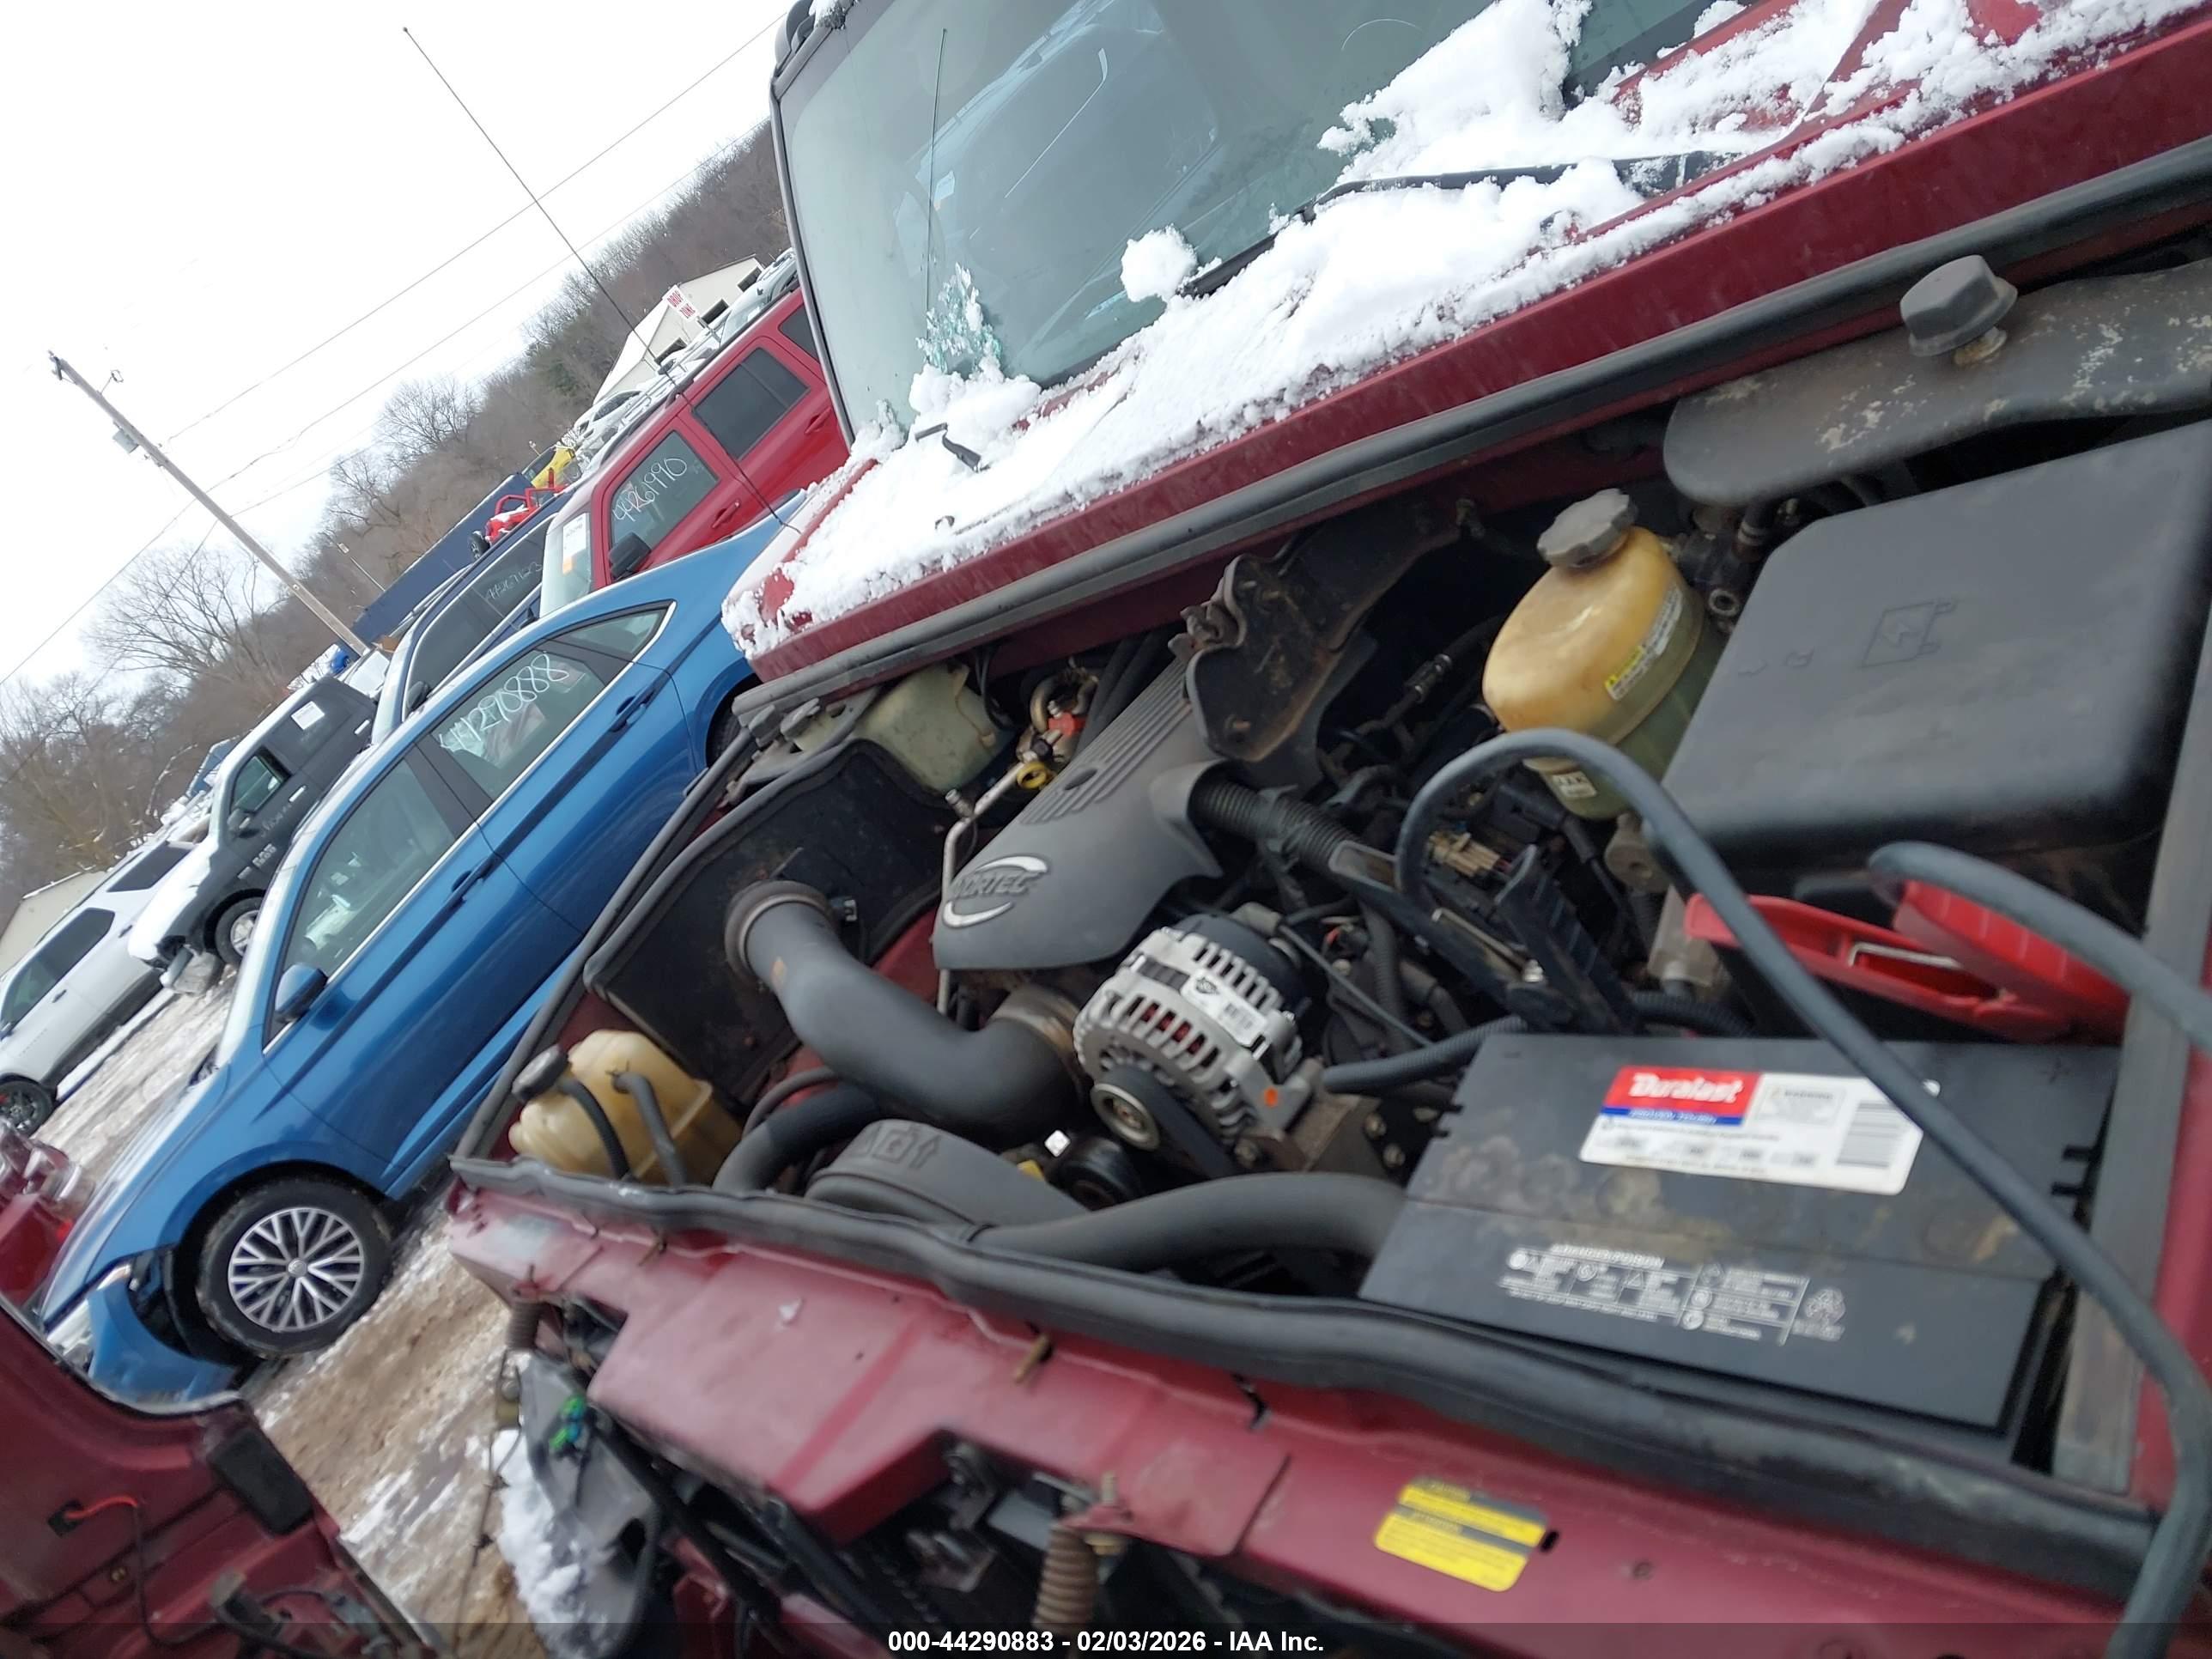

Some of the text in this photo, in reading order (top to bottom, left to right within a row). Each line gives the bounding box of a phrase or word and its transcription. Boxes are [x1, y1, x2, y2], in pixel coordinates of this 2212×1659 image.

[612, 458, 688, 522] 44261990
[439, 653, 570, 750] 44290888
[1628, 1073, 1744, 1104] Duralast
